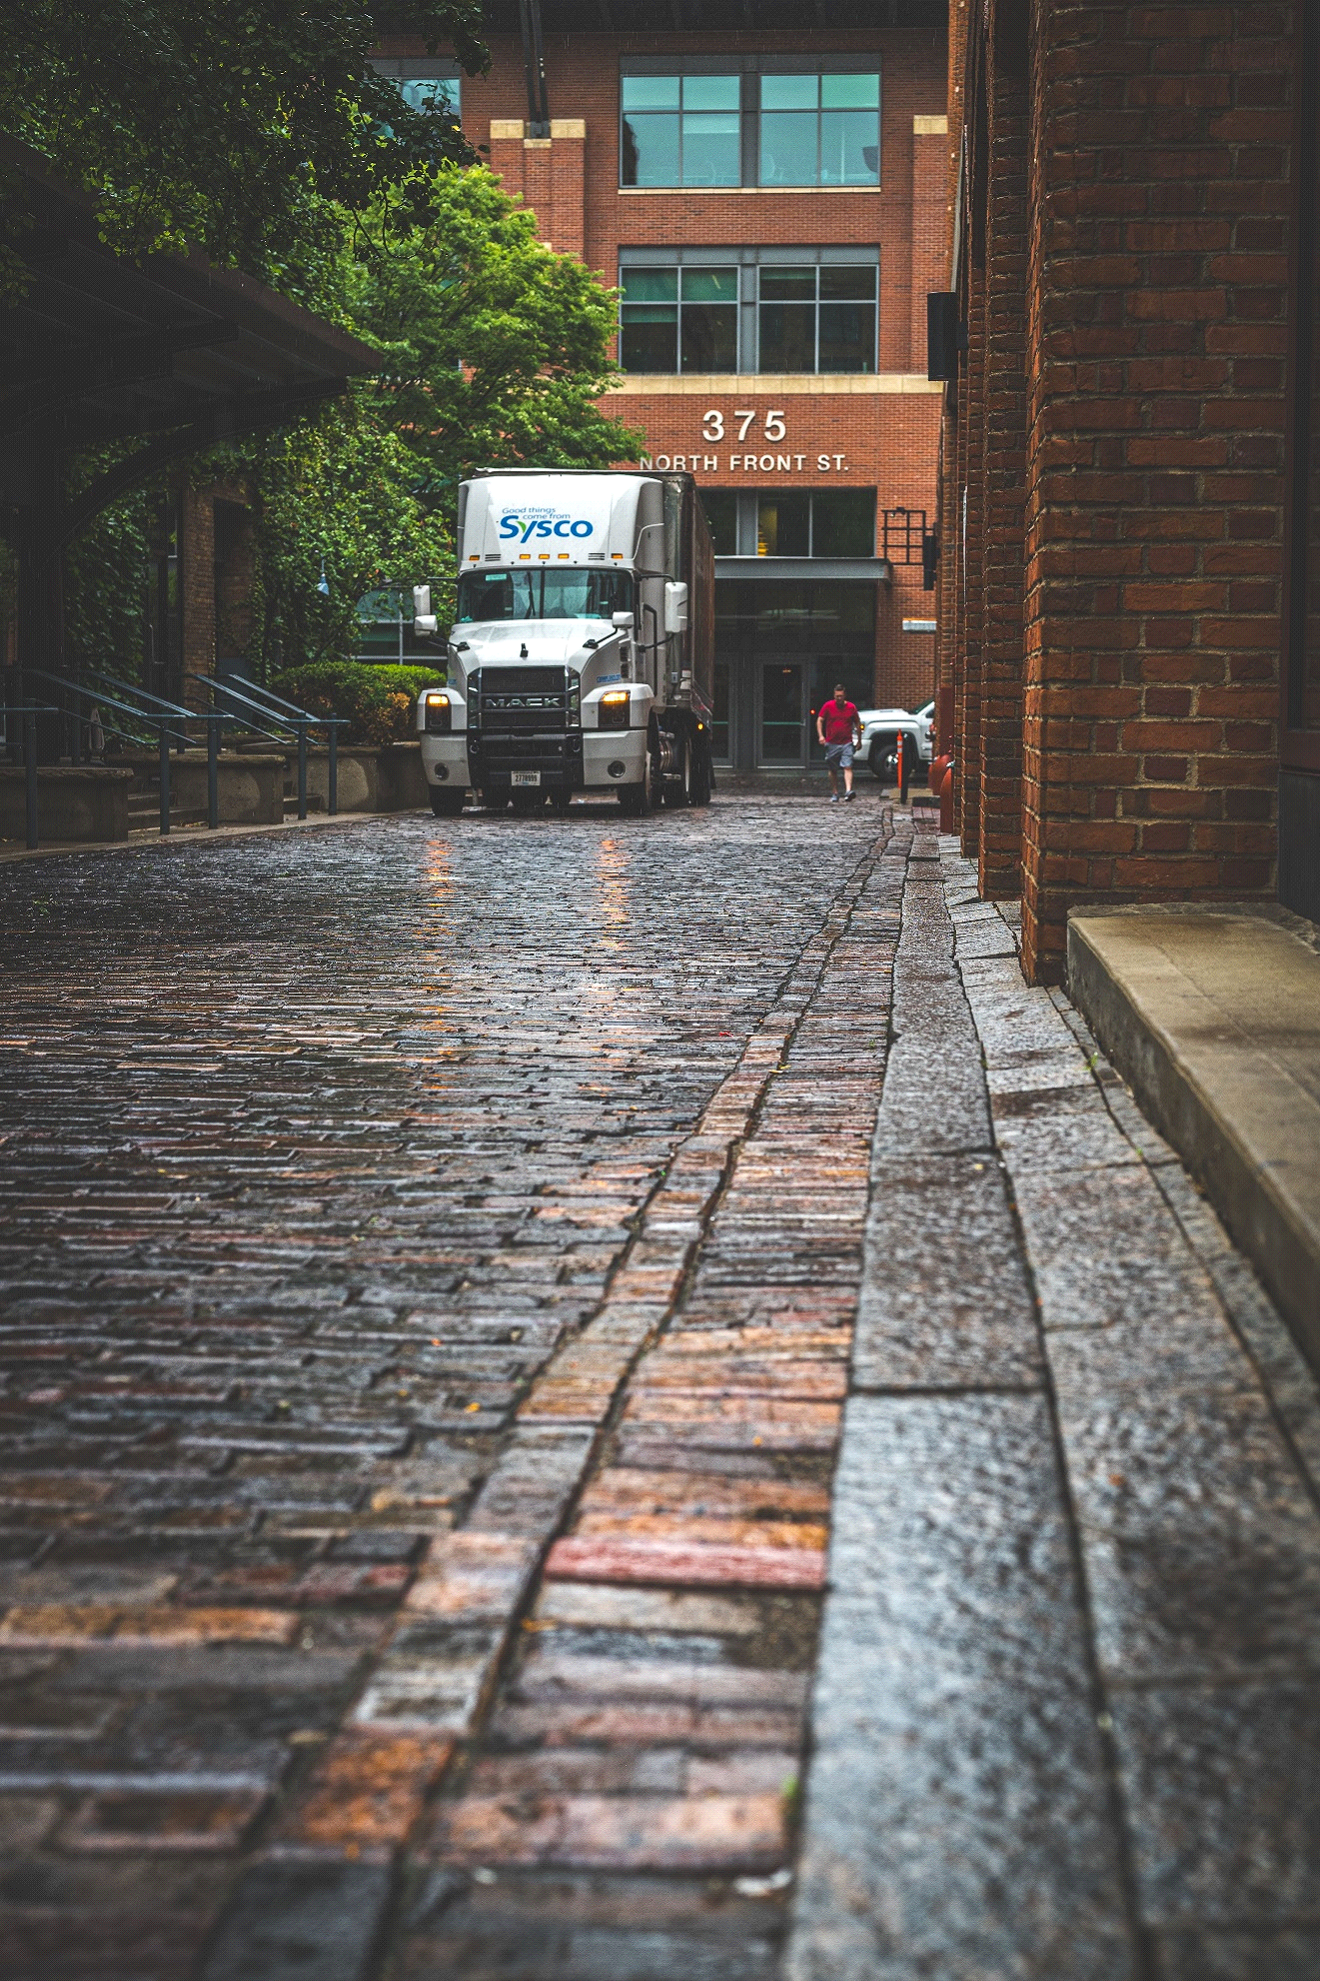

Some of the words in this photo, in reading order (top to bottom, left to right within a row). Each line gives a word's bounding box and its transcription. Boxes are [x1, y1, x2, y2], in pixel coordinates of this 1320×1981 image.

[702, 410, 787, 442] 375
[639, 455, 718, 471] NORTH
[730, 455, 807, 471] FRONT
[817, 455, 849, 471] ST.
[499, 515, 594, 543] Sysco
[485, 698, 560, 707] MACK
